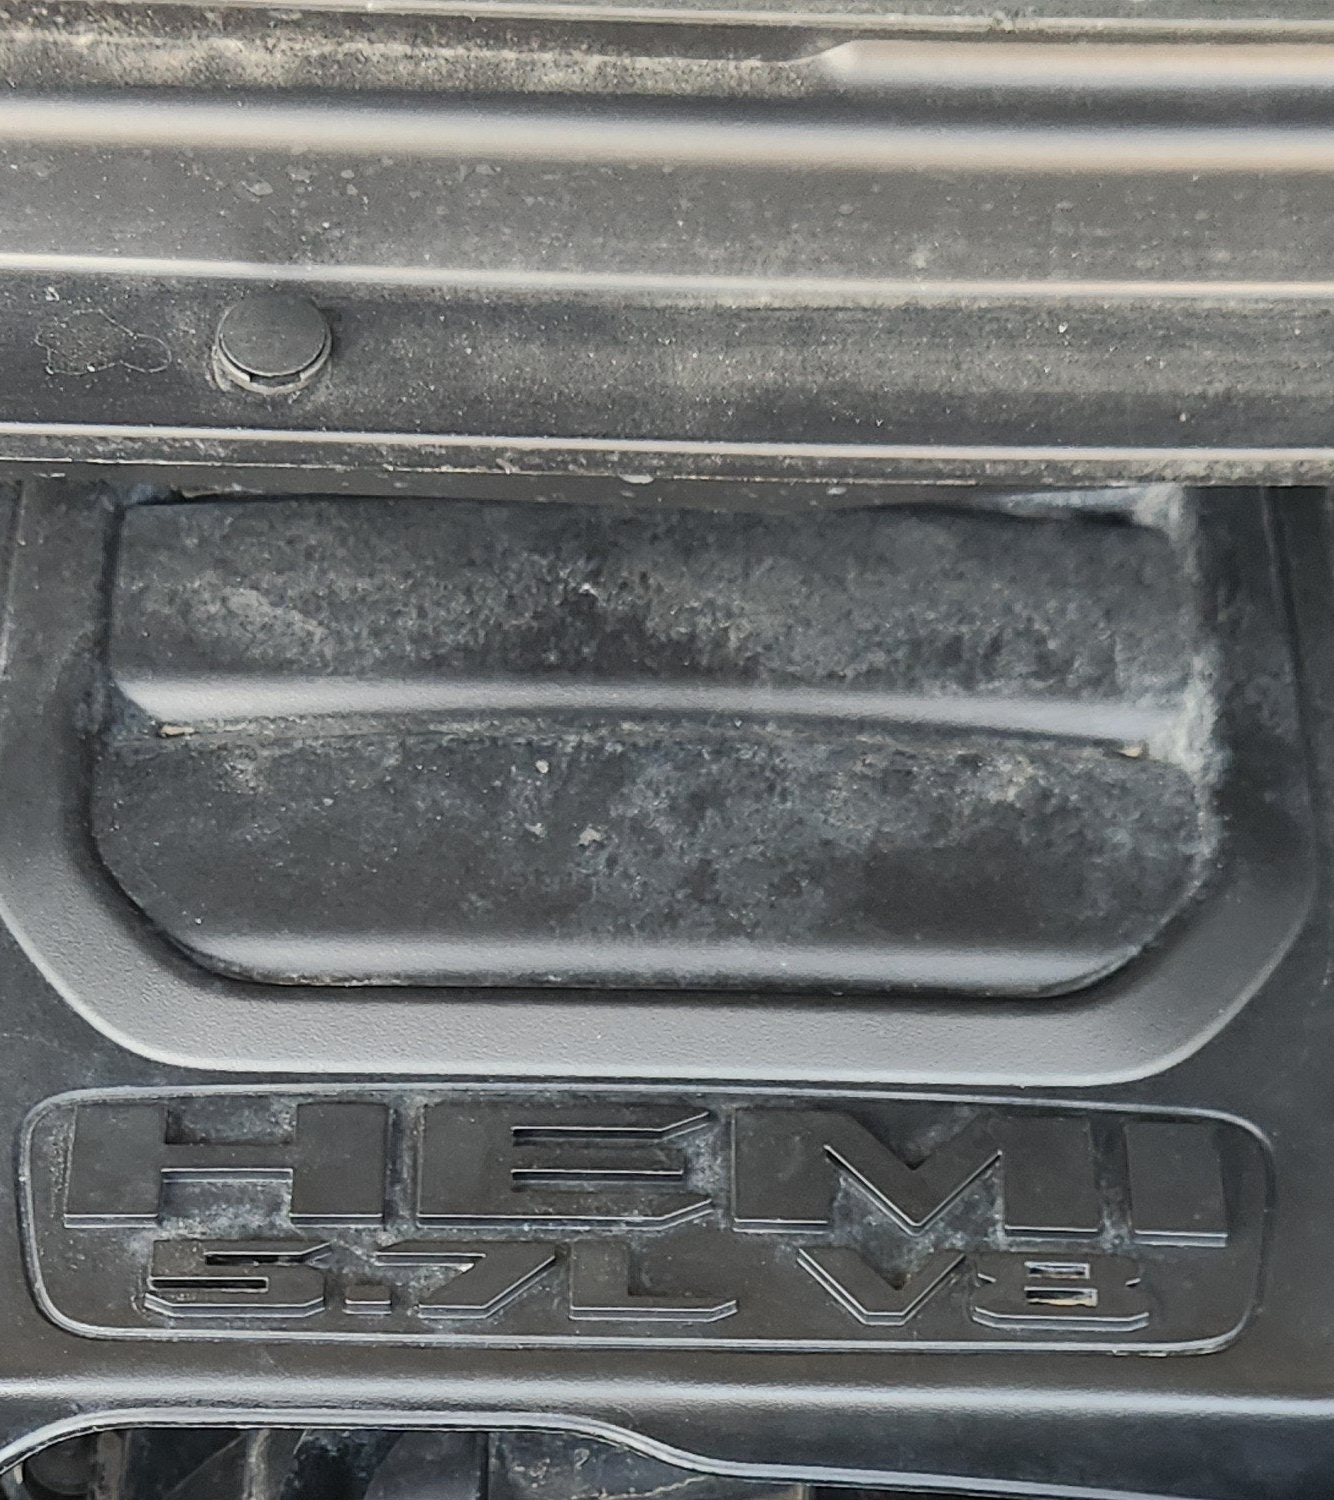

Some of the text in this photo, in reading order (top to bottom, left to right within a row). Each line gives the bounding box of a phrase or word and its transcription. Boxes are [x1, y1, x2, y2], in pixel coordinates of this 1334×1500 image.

[63, 1101, 1228, 1248] HEMI
[143, 1237, 1151, 1331] 5.7L V8
